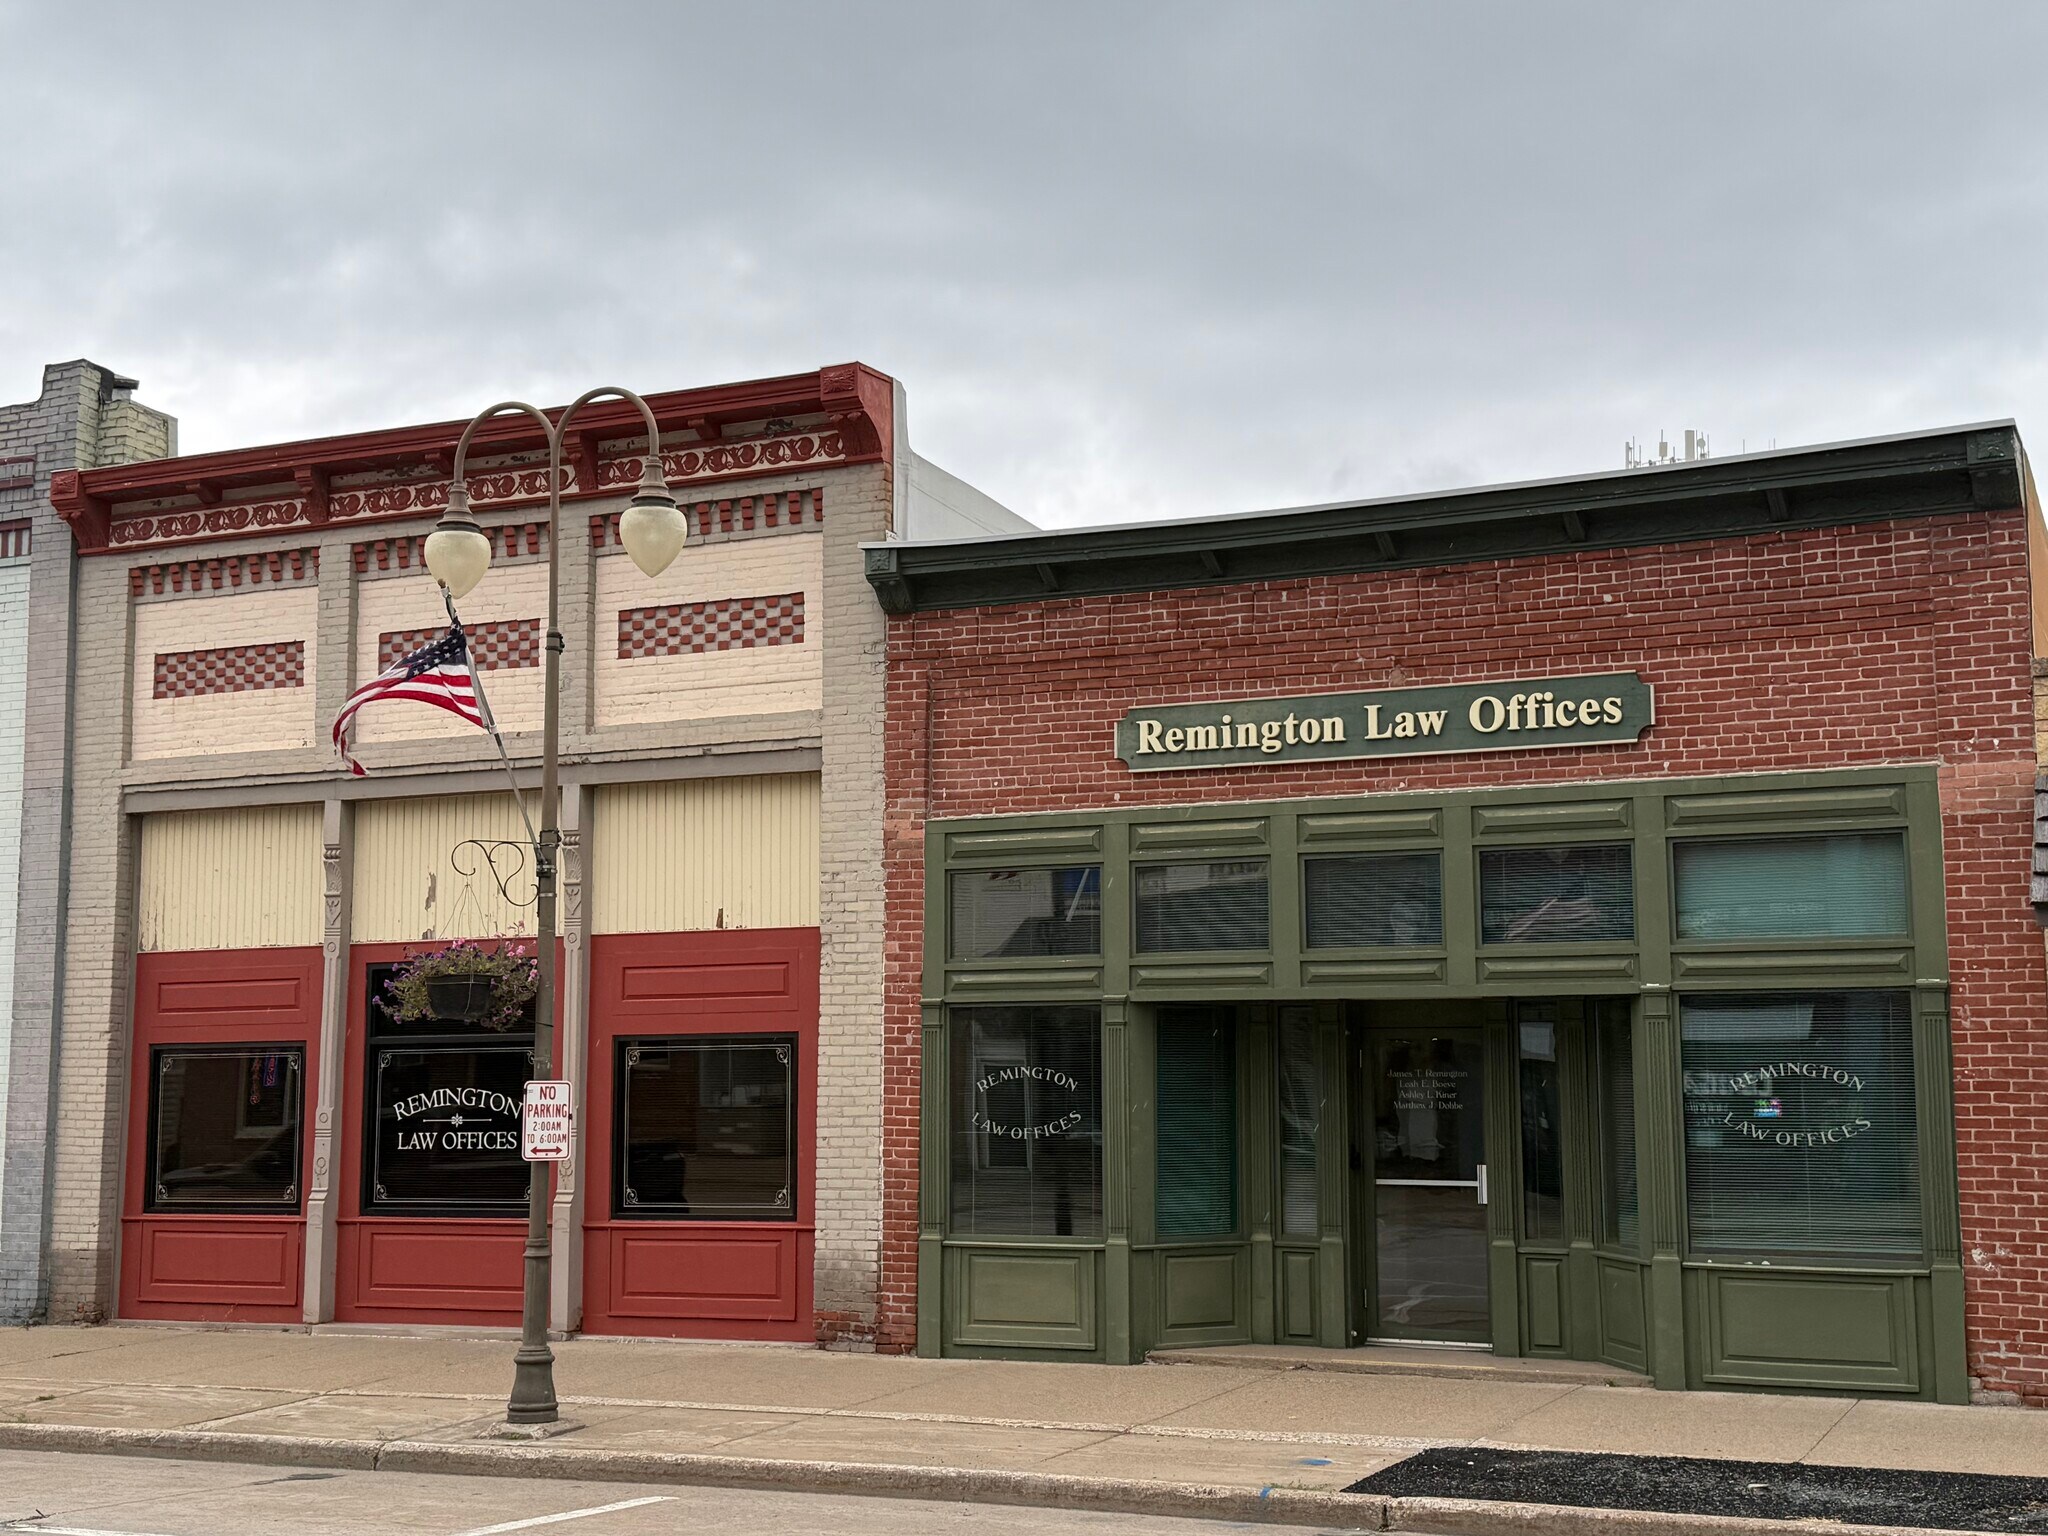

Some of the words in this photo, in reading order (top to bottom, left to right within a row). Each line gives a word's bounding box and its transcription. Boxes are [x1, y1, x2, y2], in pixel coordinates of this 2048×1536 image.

[1136, 713, 1347, 754] Remington
[1363, 704, 1448, 741] Law
[1468, 691, 1623, 734] Offices
[976, 1066, 1078, 1093] REMINGTON
[1387, 1068, 1413, 1078] James
[1425, 1068, 1468, 1079] Remington
[1729, 1062, 1865, 1092] REMINGTON
[1399, 1079, 1419, 1088] Leah
[1432, 1079, 1457, 1088] Boeve
[539, 1086, 557, 1100] NO
[1399, 1090, 1425, 1100] Ashley
[1435, 1090, 1458, 1099] Kiner
[393, 1087, 524, 1120] REMINGTON
[527, 1103, 568, 1118] PARKING
[1393, 1101, 1426, 1110] Matthew
[1438, 1101, 1464, 1110] Dobbe
[533, 1121, 562, 1131] 2:00AM
[971, 1112, 1008, 1136] LAW
[1010, 1110, 1082, 1140] OFFICES
[1723, 1111, 1770, 1140] LAW
[1775, 1116, 1872, 1147] OFFICES
[397, 1132, 438, 1150] LAW
[442, 1131, 518, 1150] OFFICES
[527, 1133, 535, 1143] TO
[539, 1133, 567, 1144] 6:00AM
